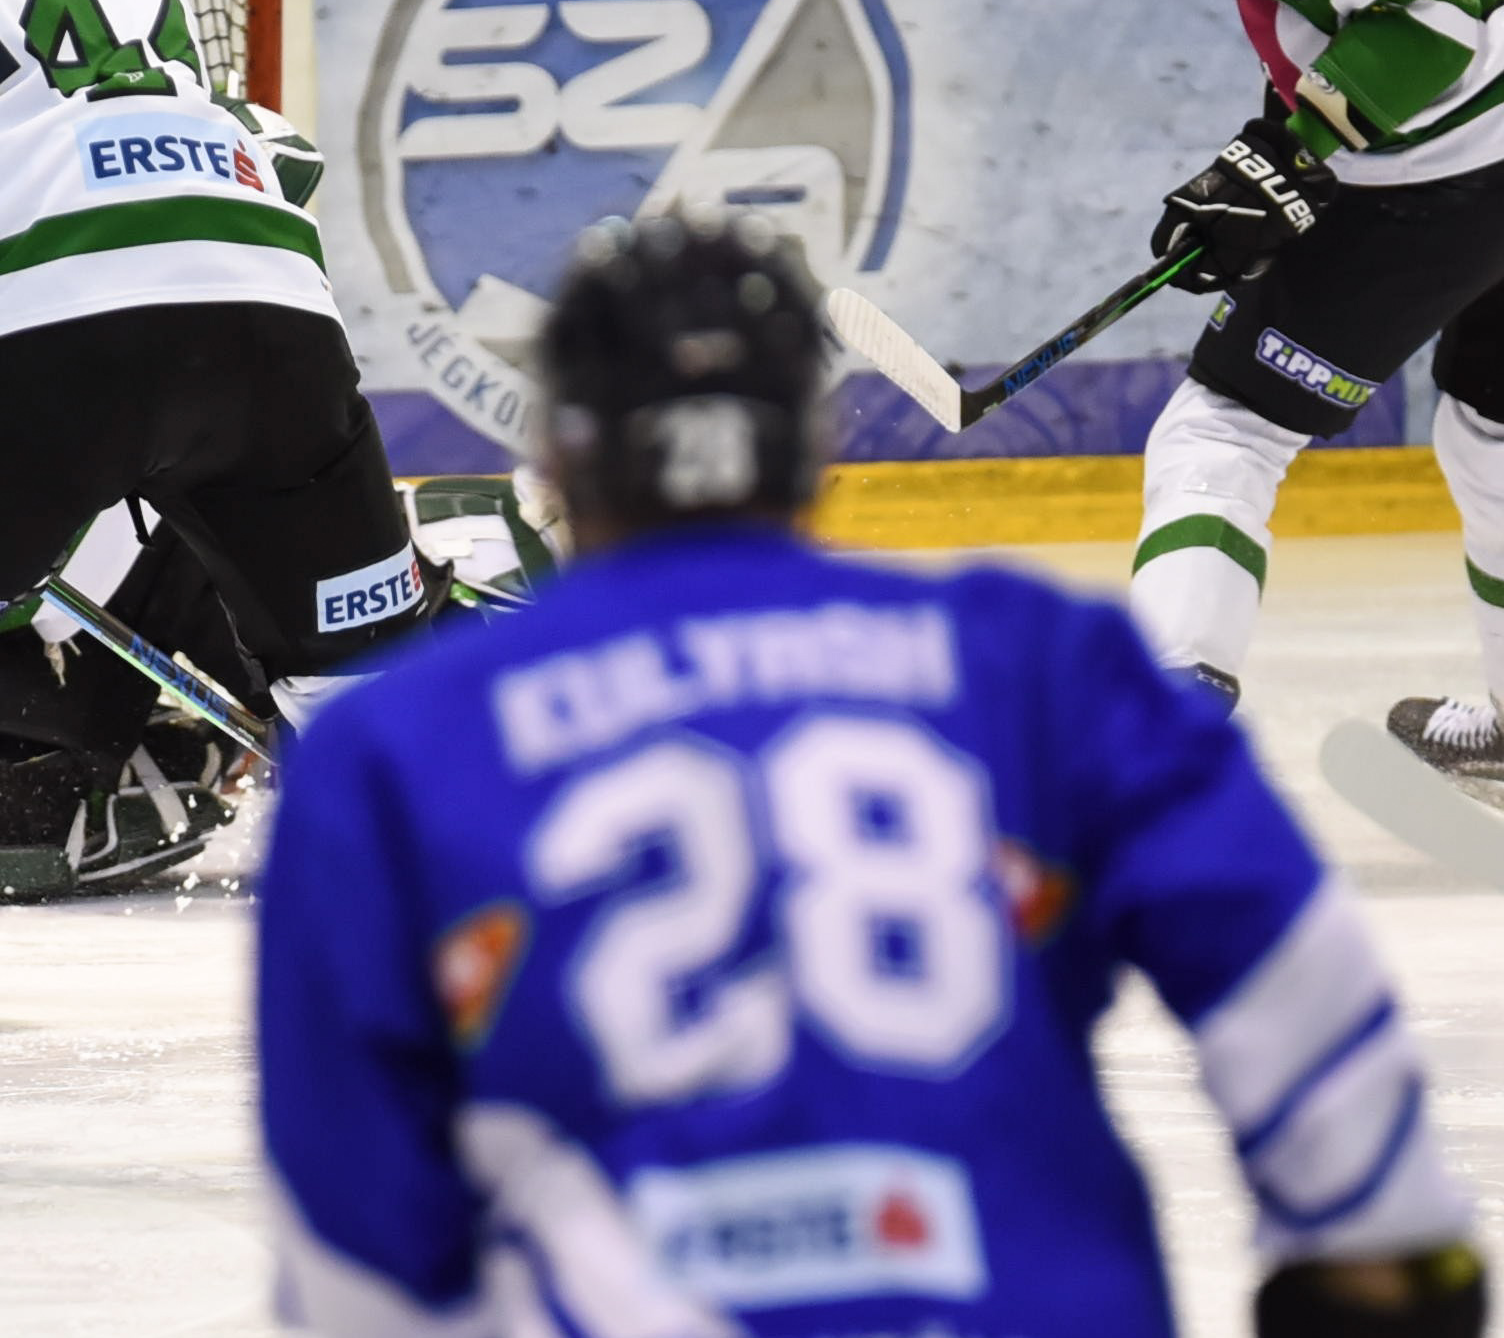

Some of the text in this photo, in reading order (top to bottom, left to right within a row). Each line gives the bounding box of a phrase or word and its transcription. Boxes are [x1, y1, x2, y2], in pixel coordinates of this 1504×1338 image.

[88, 134, 231, 181] ERSTE
[404, 321, 530, 431] JÉGKO
[324, 569, 417, 629] ERSTE
[527, 709, 1004, 1111] 28
